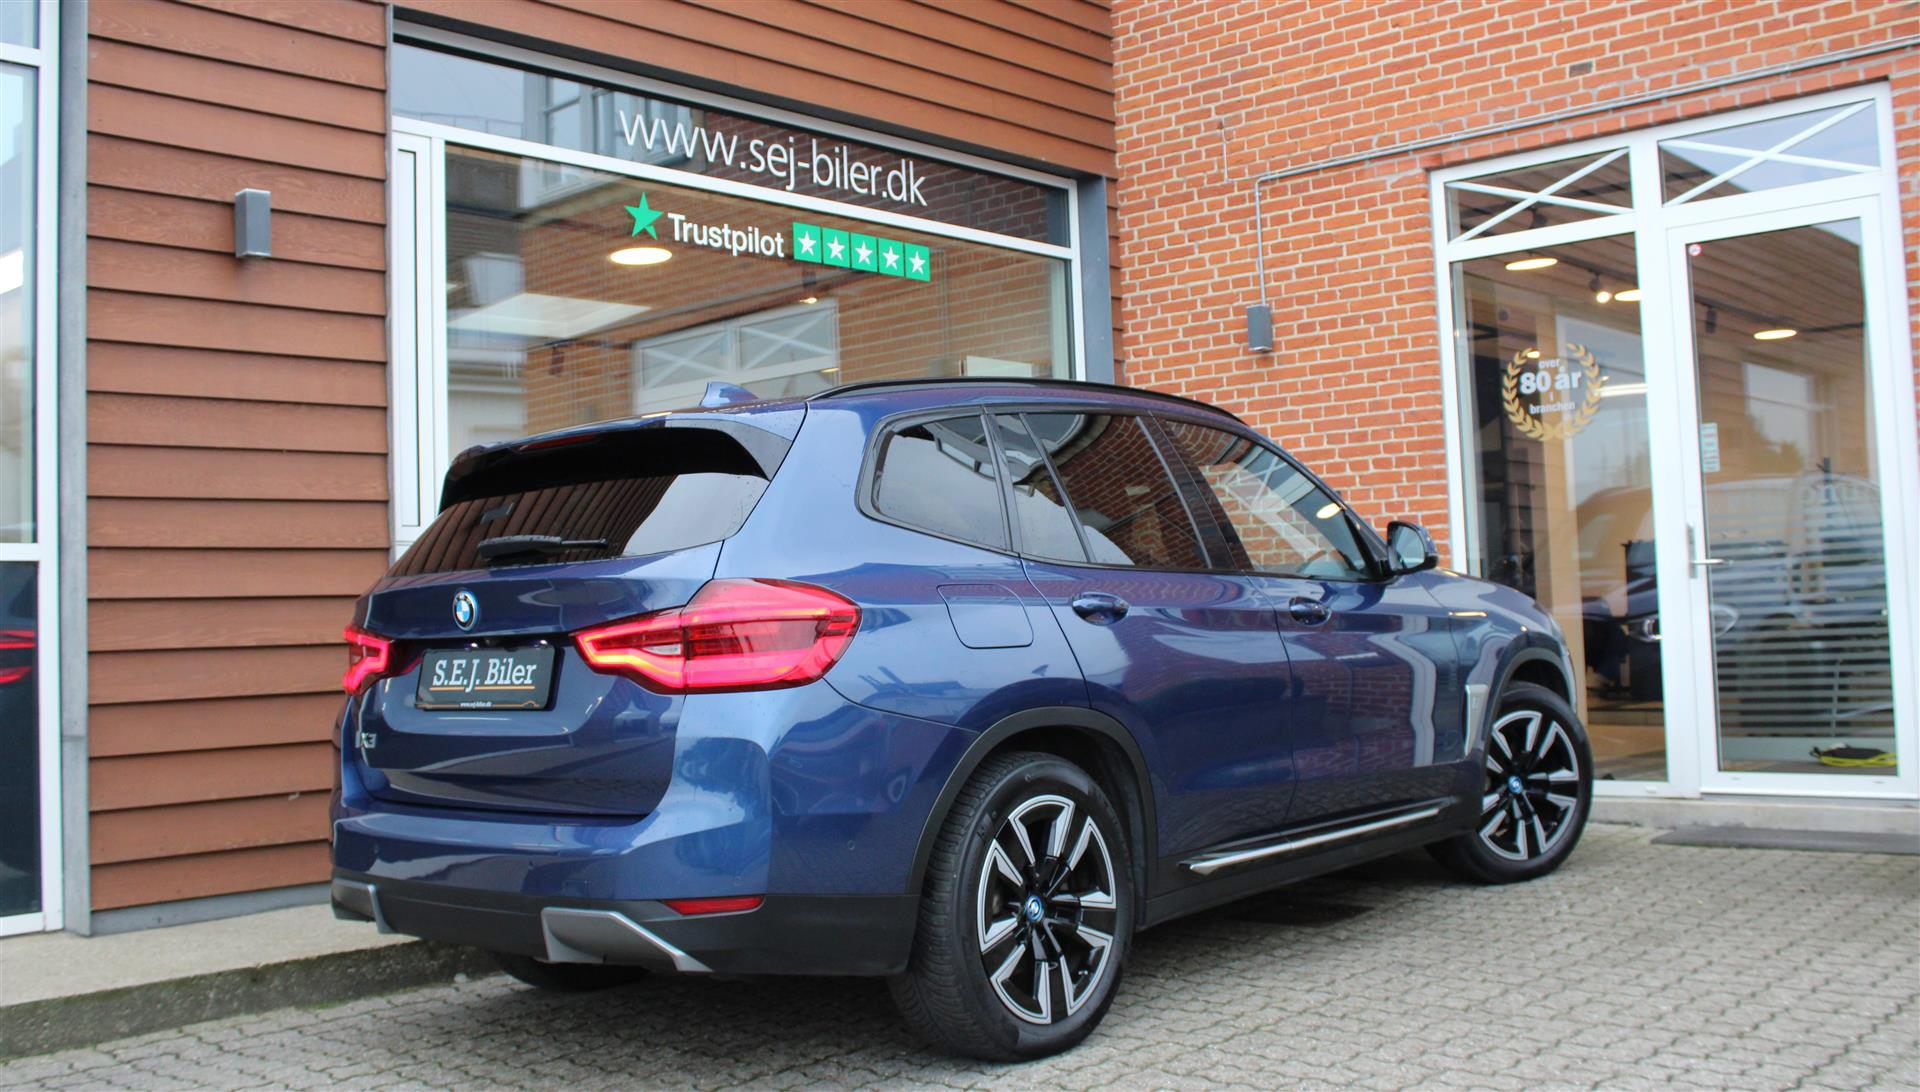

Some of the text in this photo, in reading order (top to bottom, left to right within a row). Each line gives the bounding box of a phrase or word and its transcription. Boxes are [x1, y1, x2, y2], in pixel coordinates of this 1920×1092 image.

[620, 110, 927, 206] www.sej-biler.dk
[668, 212, 784, 258] Trustpilot
[1538, 359, 1561, 369] over
[1520, 366, 1582, 395] 80 år
[1529, 402, 1575, 415] branchen
[433, 658, 537, 692] S.E.J. Biler
